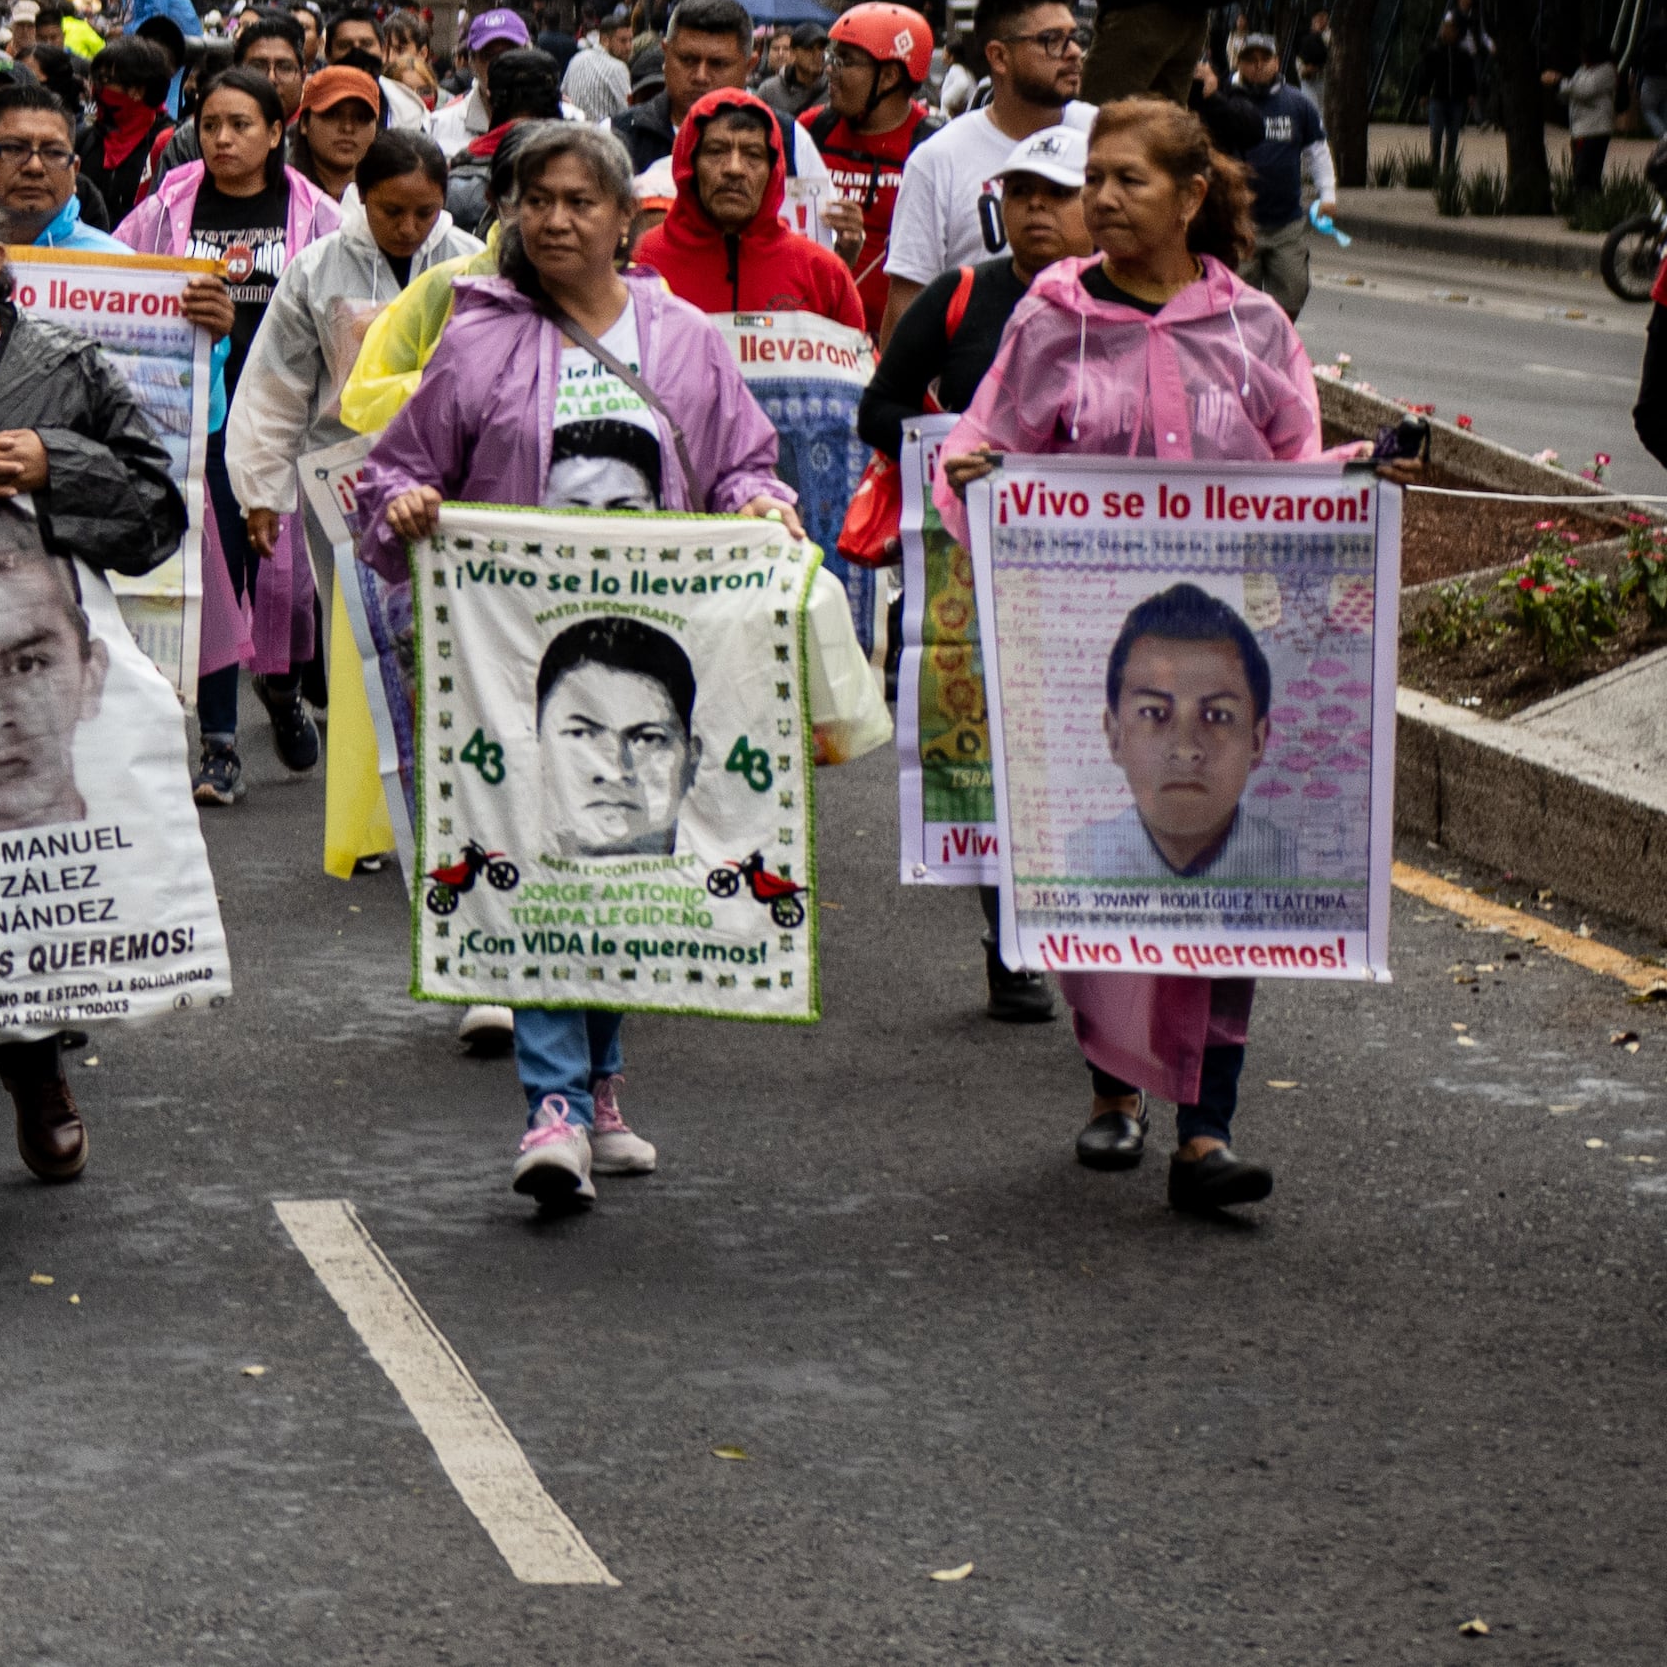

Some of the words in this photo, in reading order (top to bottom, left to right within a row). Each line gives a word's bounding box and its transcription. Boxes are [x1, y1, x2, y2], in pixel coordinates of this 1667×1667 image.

[49, 278, 184, 318] llevaron
[740, 334, 861, 372] llevaron!
[999, 482, 1089, 525] ¡Vivo
[1103, 492, 1144, 518] se
[1158, 485, 1191, 519] lo
[1205, 486, 1370, 523] llevaron!
[456, 559, 538, 590] ¡Vivo
[547, 571, 581, 592] se
[591, 569, 621, 595] lo
[630, 566, 774, 596] llevaron!
[460, 727, 505, 784] 43
[725, 735, 773, 792] 43
[2, 826, 133, 864] MANUEL
[520, 883, 593, 902] JORGE
[1093, 892, 1148, 908] JOVANY
[508, 907, 585, 927] TIZAPA
[28, 927, 195, 974] QUEREMOS!
[458, 929, 515, 958] ¡Con
[522, 932, 585, 956] VIDA
[591, 930, 617, 956] lo
[624, 937, 768, 964] queremos!
[1039, 934, 1122, 971] ¡Vivo
[1129, 935, 1162, 965] lo
[1172, 937, 1347, 972] queremos!
[24, 991, 42, 1004] DE
[107, 981, 124, 993] LA
